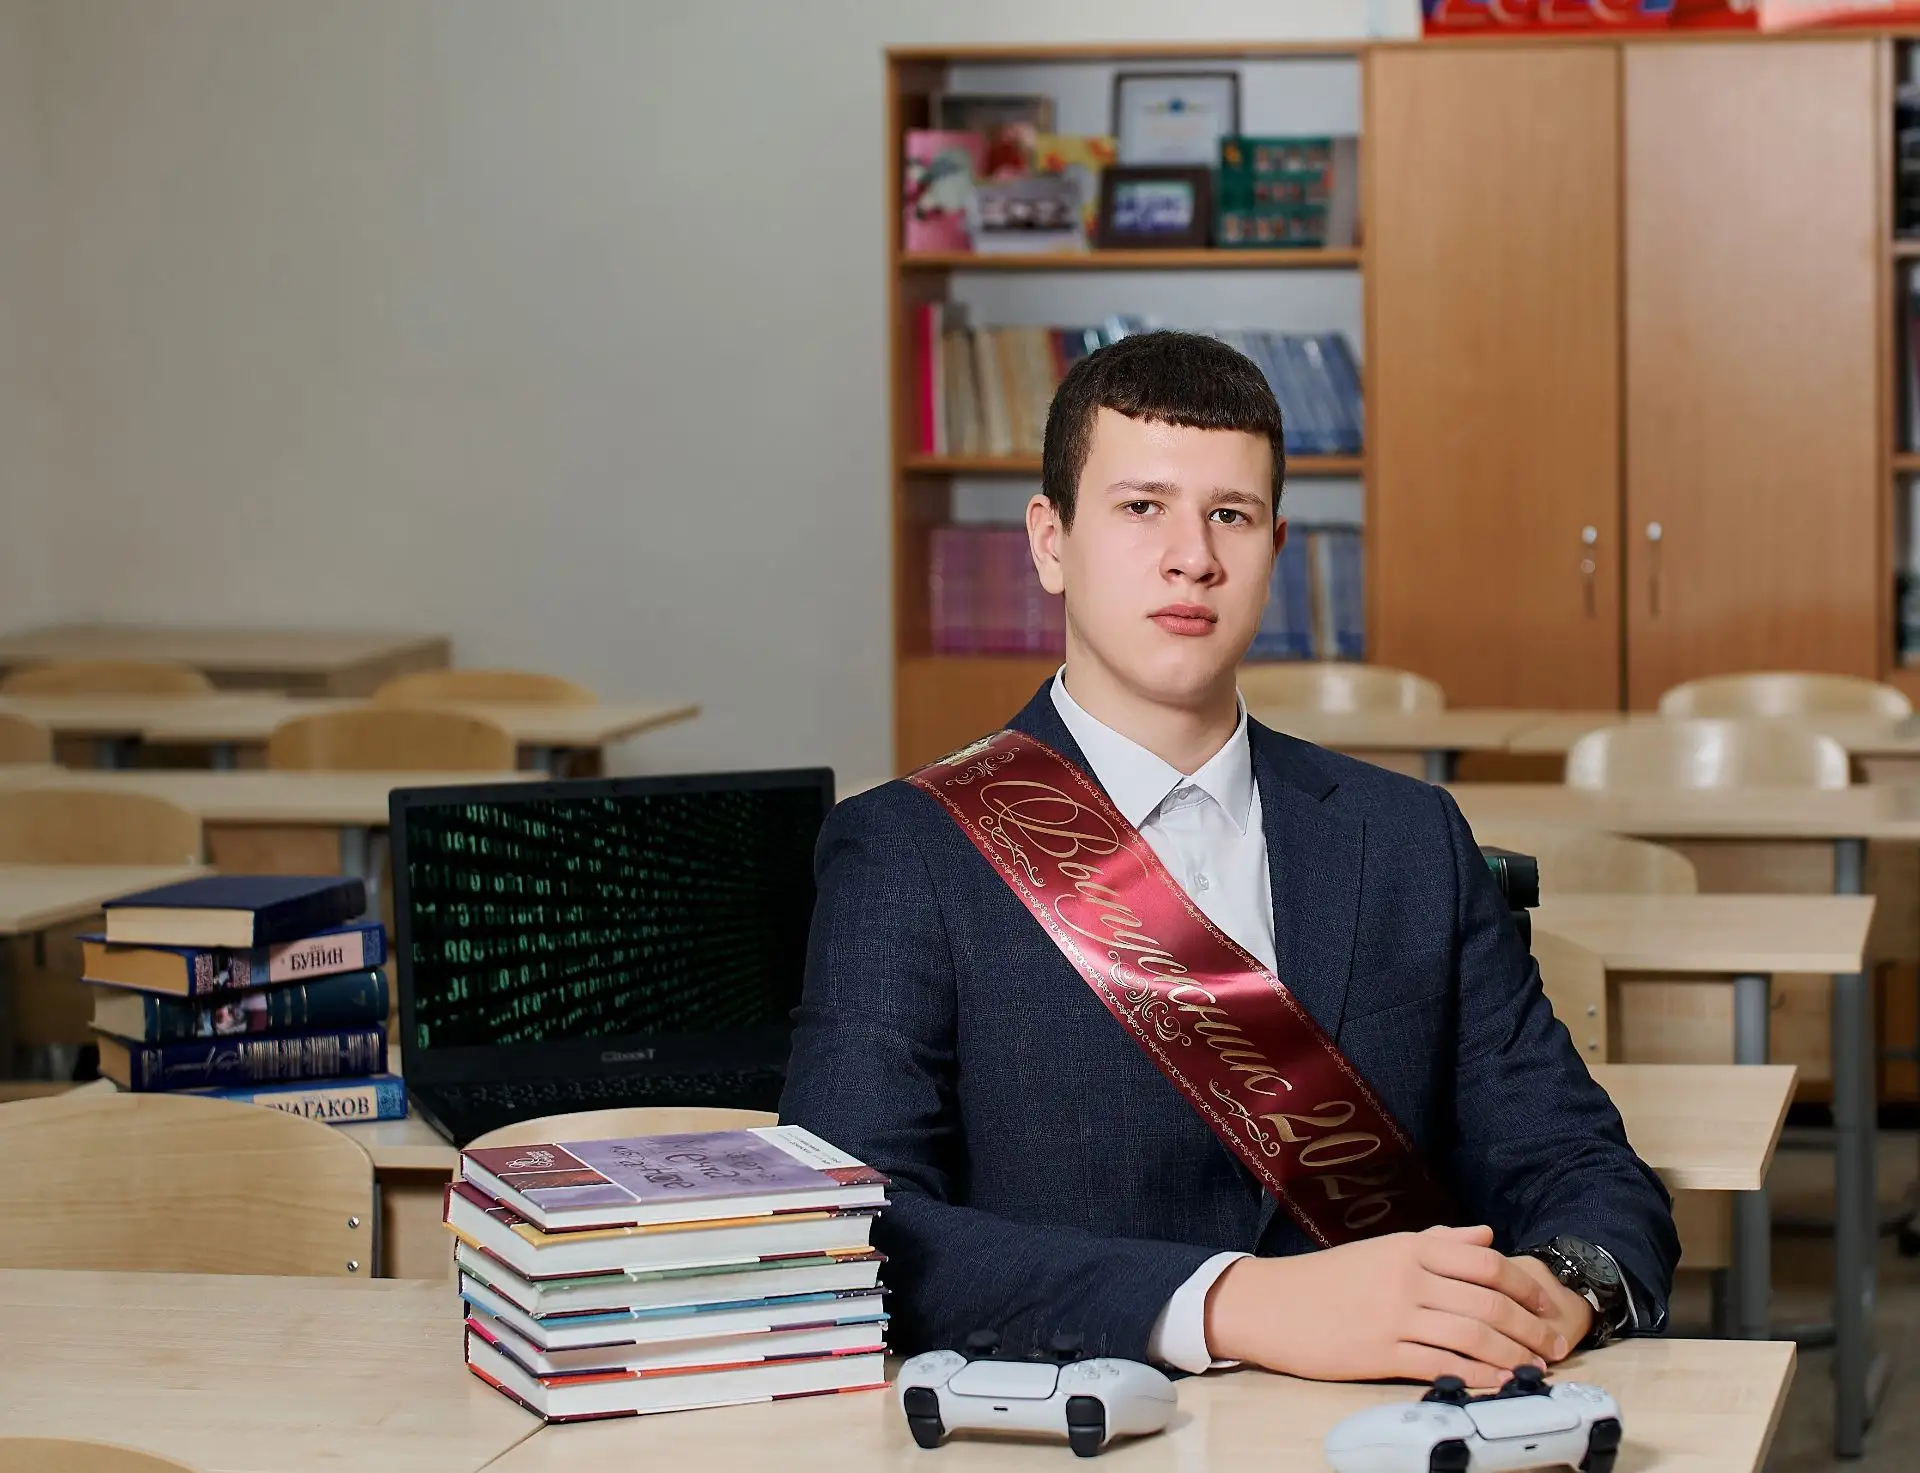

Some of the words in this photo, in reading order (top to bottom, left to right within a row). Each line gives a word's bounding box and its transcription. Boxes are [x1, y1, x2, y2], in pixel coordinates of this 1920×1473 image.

[290, 947, 344, 971] БУНИН
[979, 780, 1293, 1096] Выпускник
[1258, 1100, 1405, 1230] 2026
